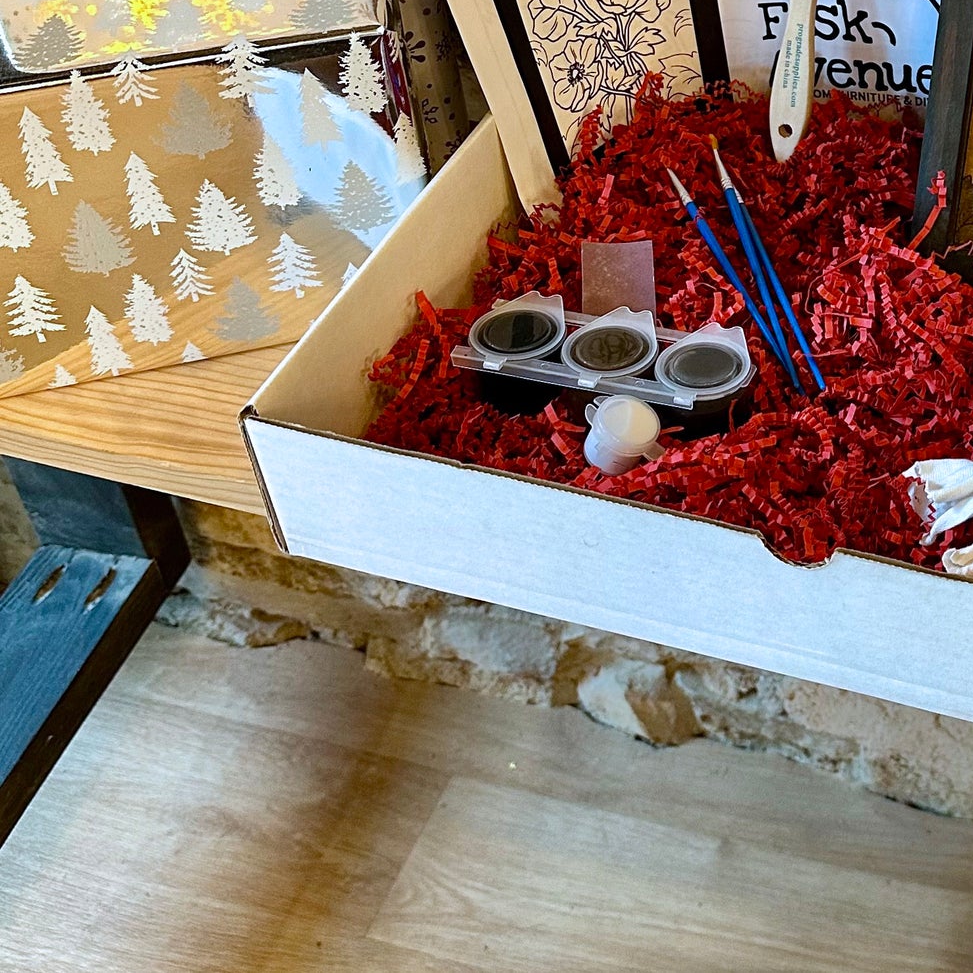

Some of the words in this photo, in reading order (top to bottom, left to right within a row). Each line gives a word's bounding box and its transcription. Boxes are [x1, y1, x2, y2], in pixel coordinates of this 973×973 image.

[784, 60, 791, 68] in
[790, 23, 804, 108] progradesupplies.com
[782, 68, 790, 89] china
[903, 95, 913, 106] &
[915, 96, 929, 107] DI
